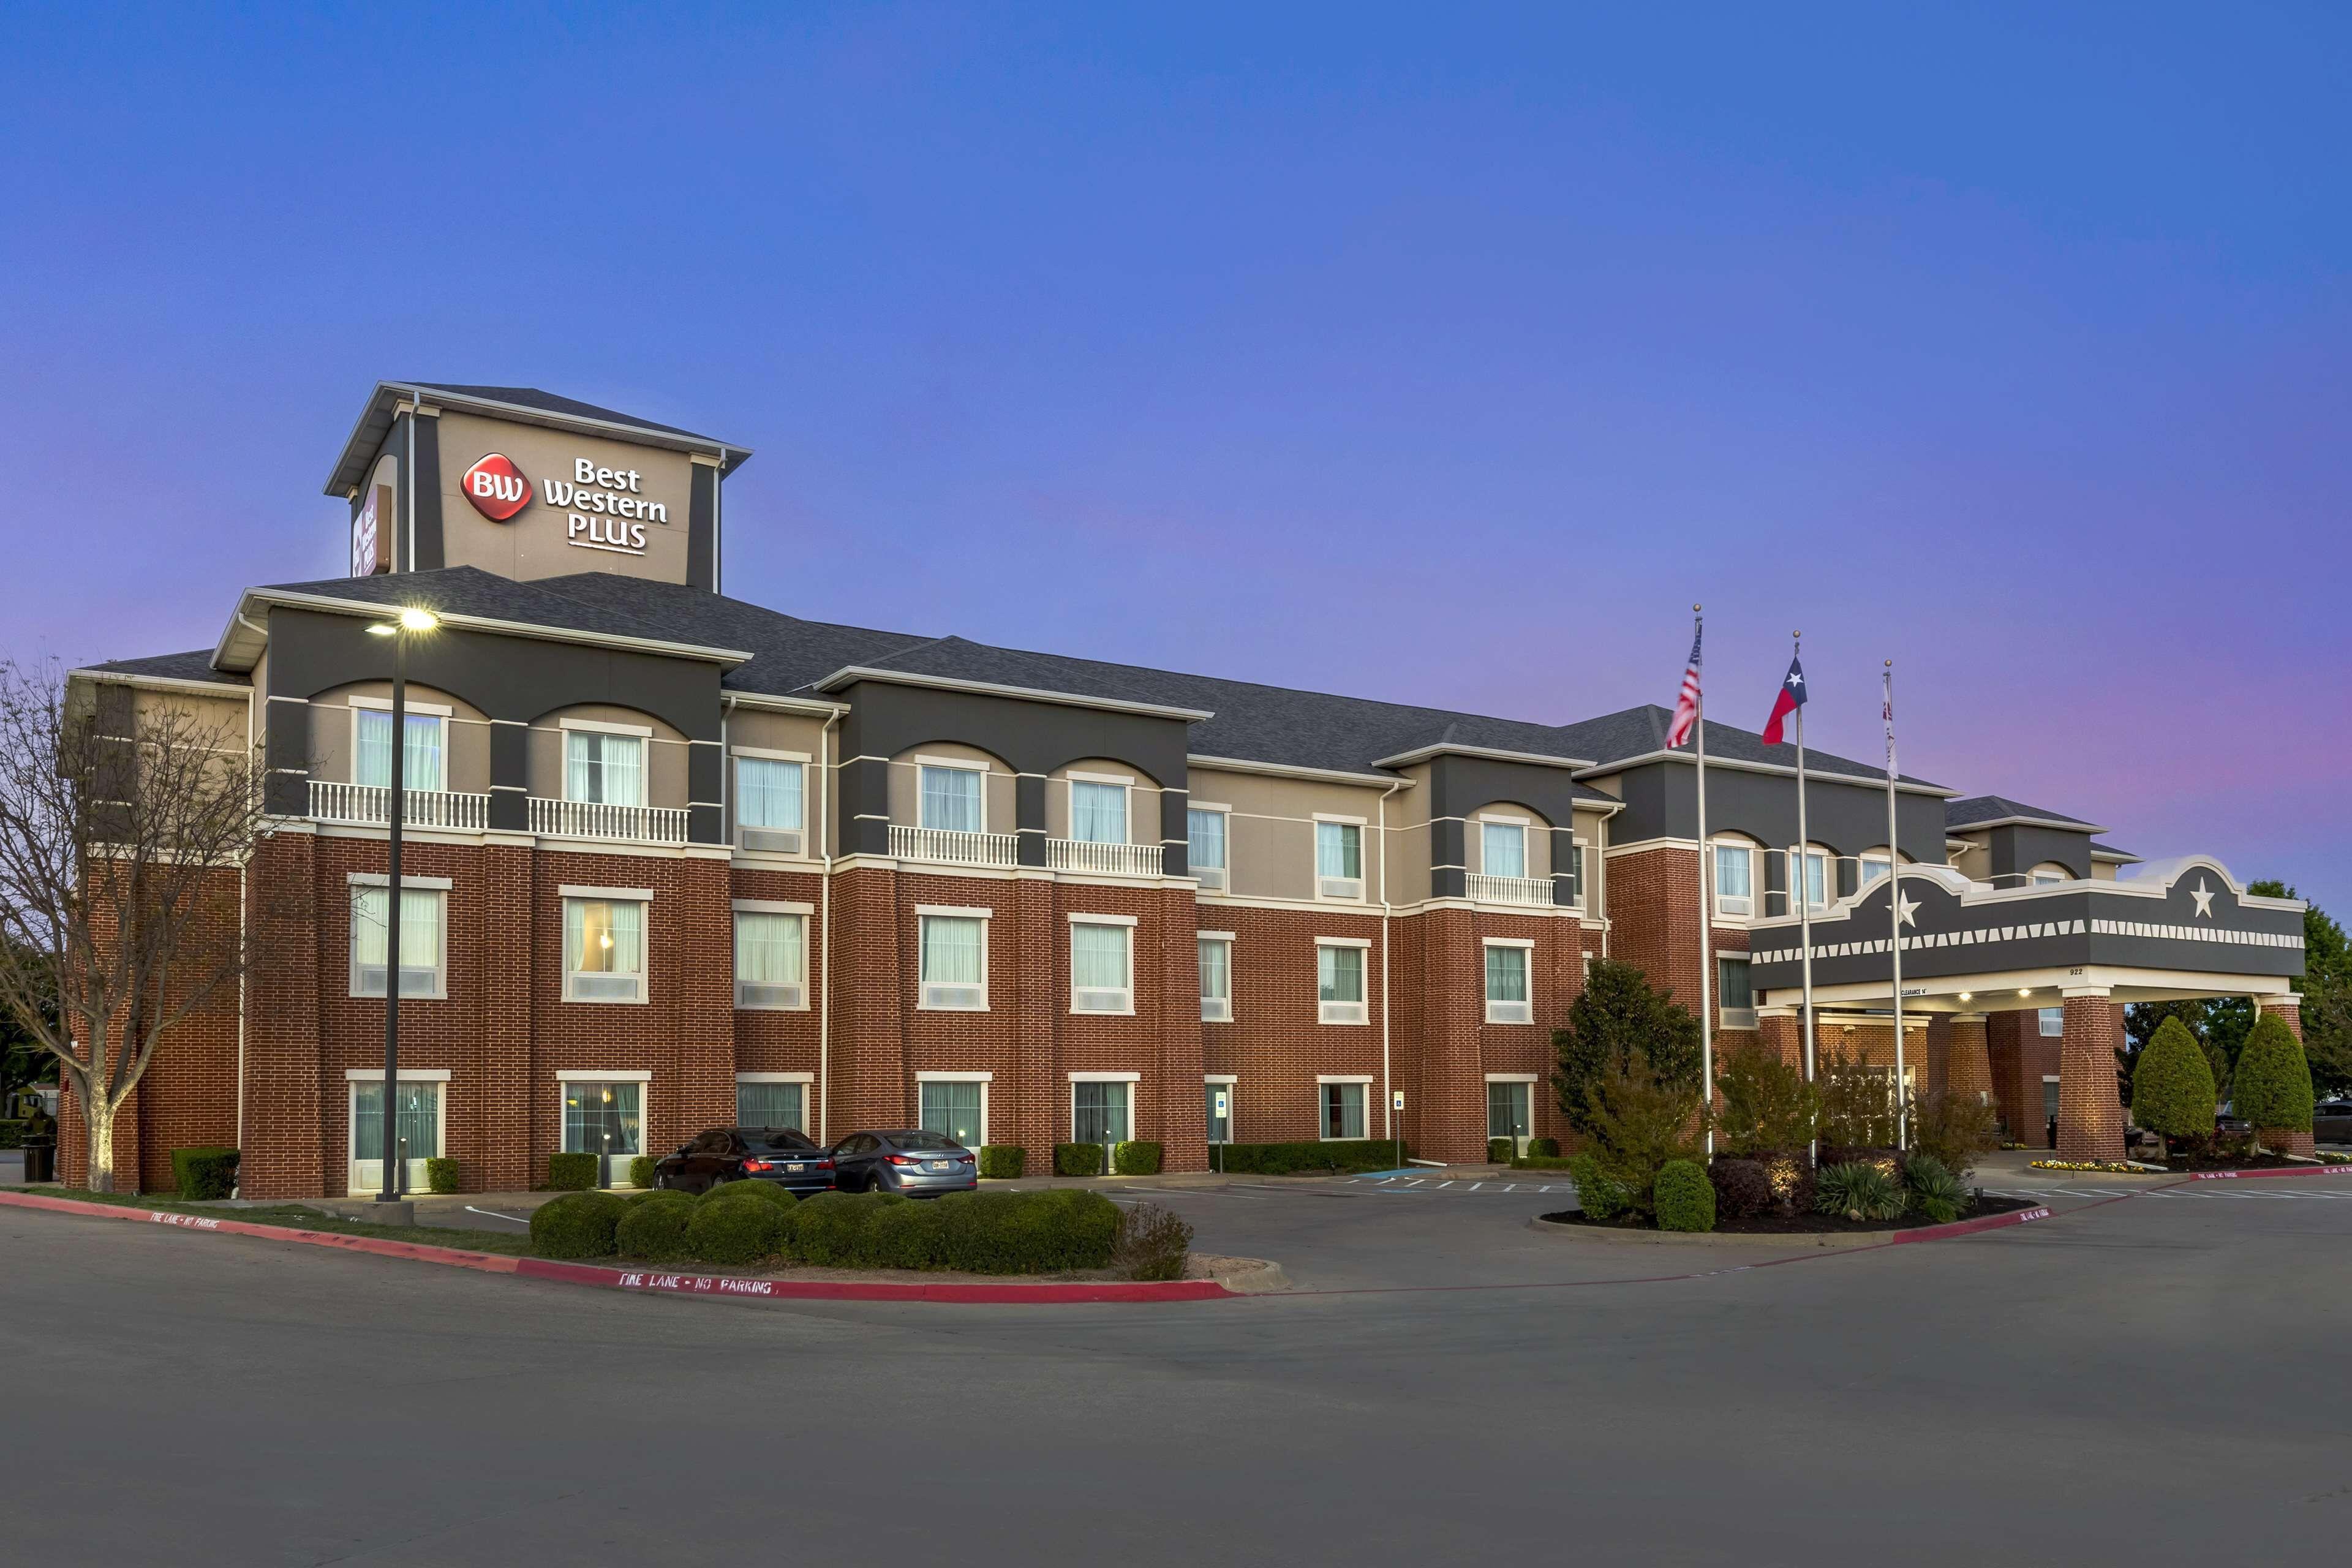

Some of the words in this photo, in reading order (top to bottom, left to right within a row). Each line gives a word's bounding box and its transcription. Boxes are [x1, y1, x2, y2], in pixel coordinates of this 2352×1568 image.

[473, 471, 524, 502] BW
[574, 458, 640, 493] Best
[543, 479, 668, 523] Western
[568, 513, 646, 549] PLUS
[164, 1214, 181, 1224] LANE
[619, 1273, 644, 1286] FIRE
[649, 1275, 680, 1287] LANE
[695, 1278, 711, 1289] NO
[720, 1279, 772, 1294] PARKING
